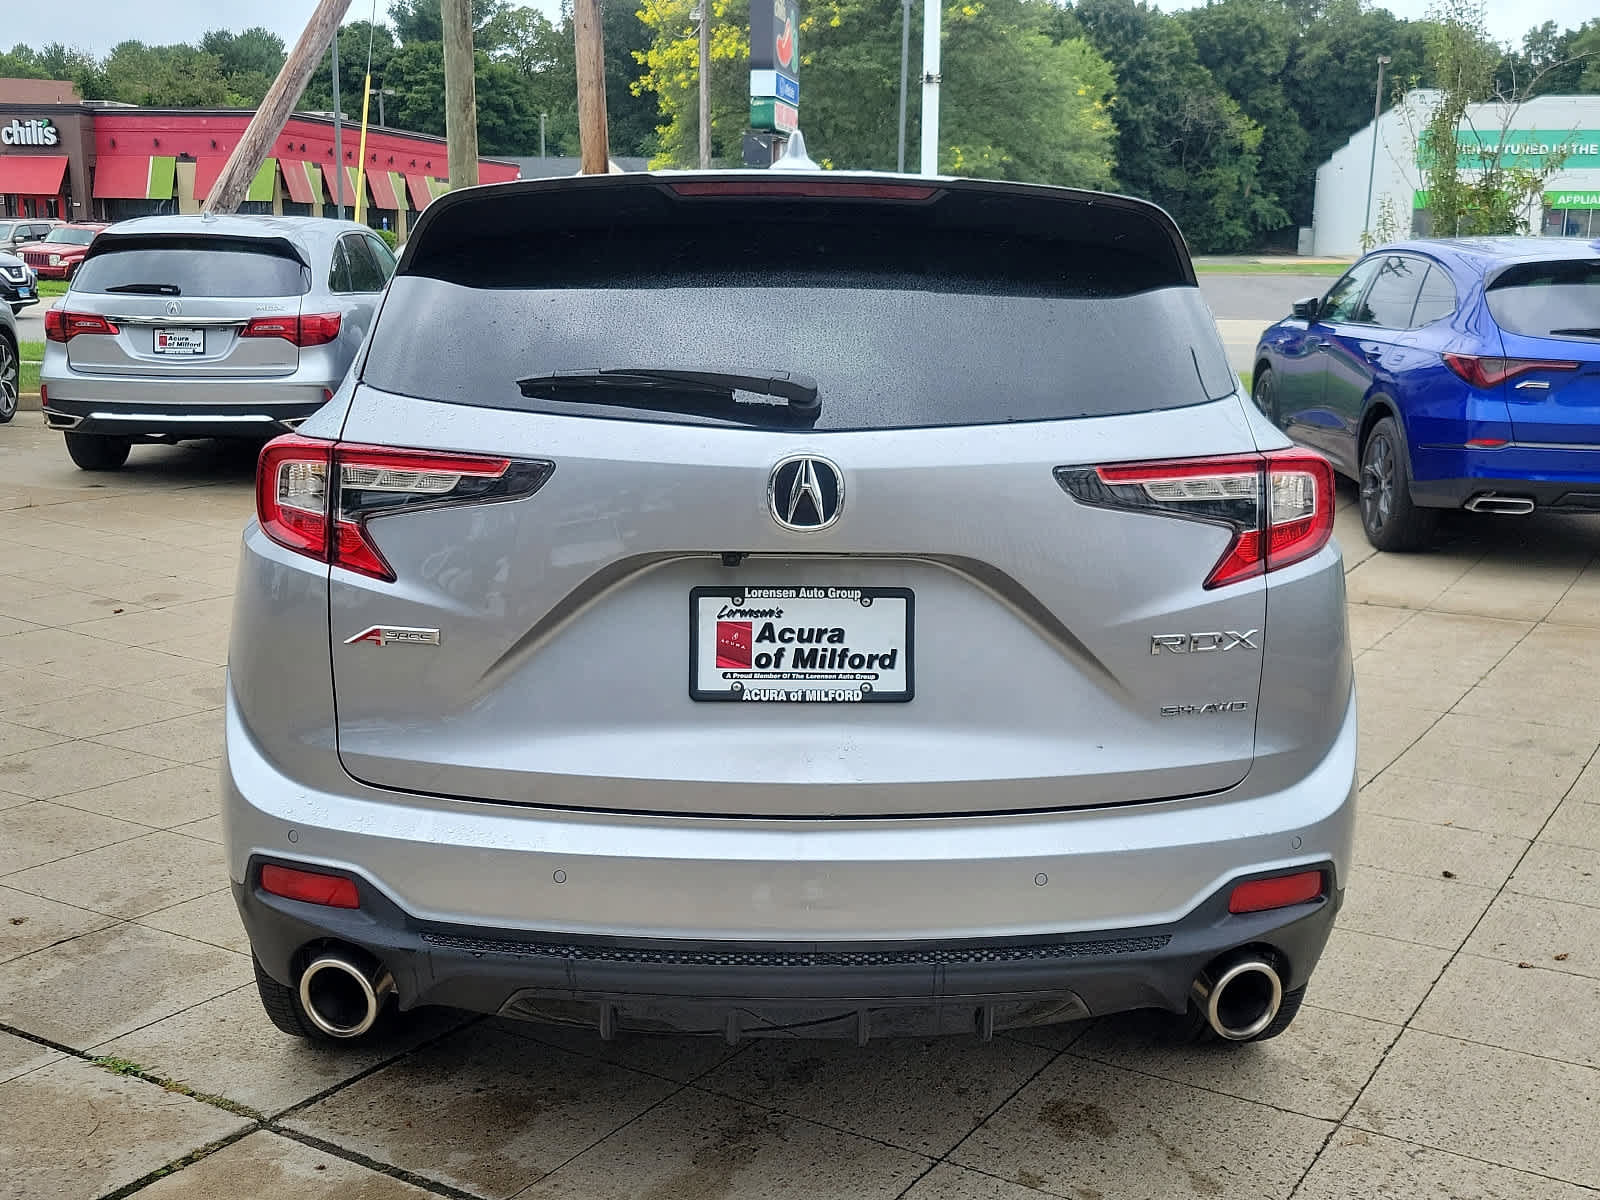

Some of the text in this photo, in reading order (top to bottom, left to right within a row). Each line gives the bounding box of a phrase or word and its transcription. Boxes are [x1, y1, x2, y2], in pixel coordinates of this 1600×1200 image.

[1572, 144, 1599, 155] THE
[1557, 194, 1600, 205] APPLIA
[744, 587, 862, 600] Lorensen Auto Group
[716, 605, 784, 619] Lorensen's
[755, 621, 846, 644] Acura
[721, 639, 747, 650] ACURA
[1151, 629, 1259, 655] RDX
[754, 647, 898, 669] of Milford
[742, 689, 863, 702] ACURA of MILFORD
